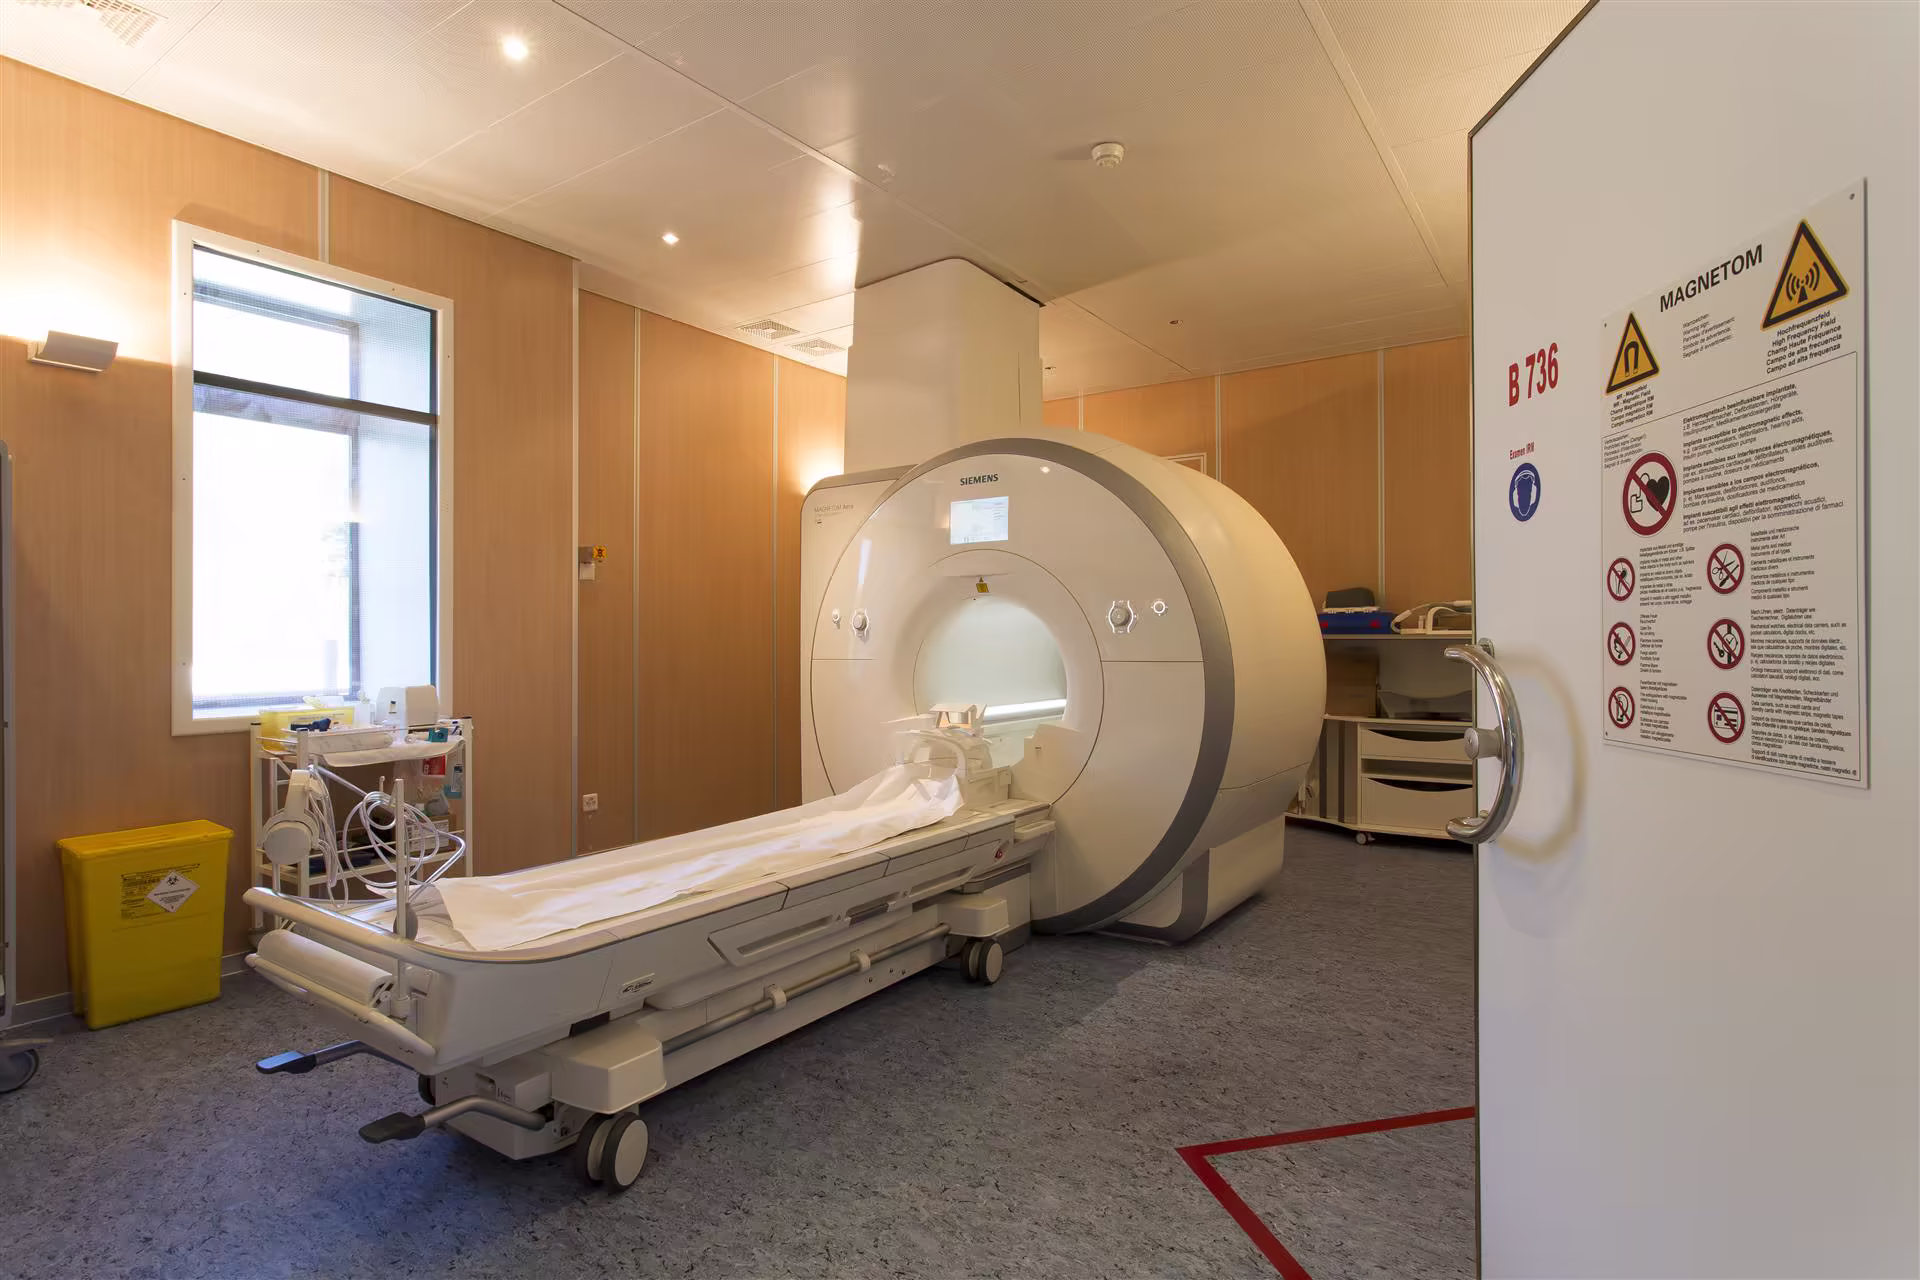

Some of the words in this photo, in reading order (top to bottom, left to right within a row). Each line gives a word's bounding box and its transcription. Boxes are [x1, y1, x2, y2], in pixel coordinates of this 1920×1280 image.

[1660, 243, 1763, 313] MAGNETOM
[1767, 344, 1788, 358] Champ
[1788, 336, 1806, 350] Haute
[1772, 336, 1785, 348] High
[1787, 323, 1818, 343] Frequency
[1820, 317, 1836, 330] Field
[1766, 352, 1786, 366] Campo
[1788, 349, 1795, 359] de
[1796, 345, 1808, 356] alta
[1808, 332, 1842, 351] frecuencia
[1766, 361, 1786, 375] Campo
[1788, 358, 1795, 368] ad
[1797, 353, 1808, 364] alta
[1809, 342, 1841, 360] frequenza
[1509, 363, 1519, 407] B
[1526, 342, 1558, 398] 736
[1510, 447, 1526, 460] Examen
[960, 474, 998, 486] SIEMENS
